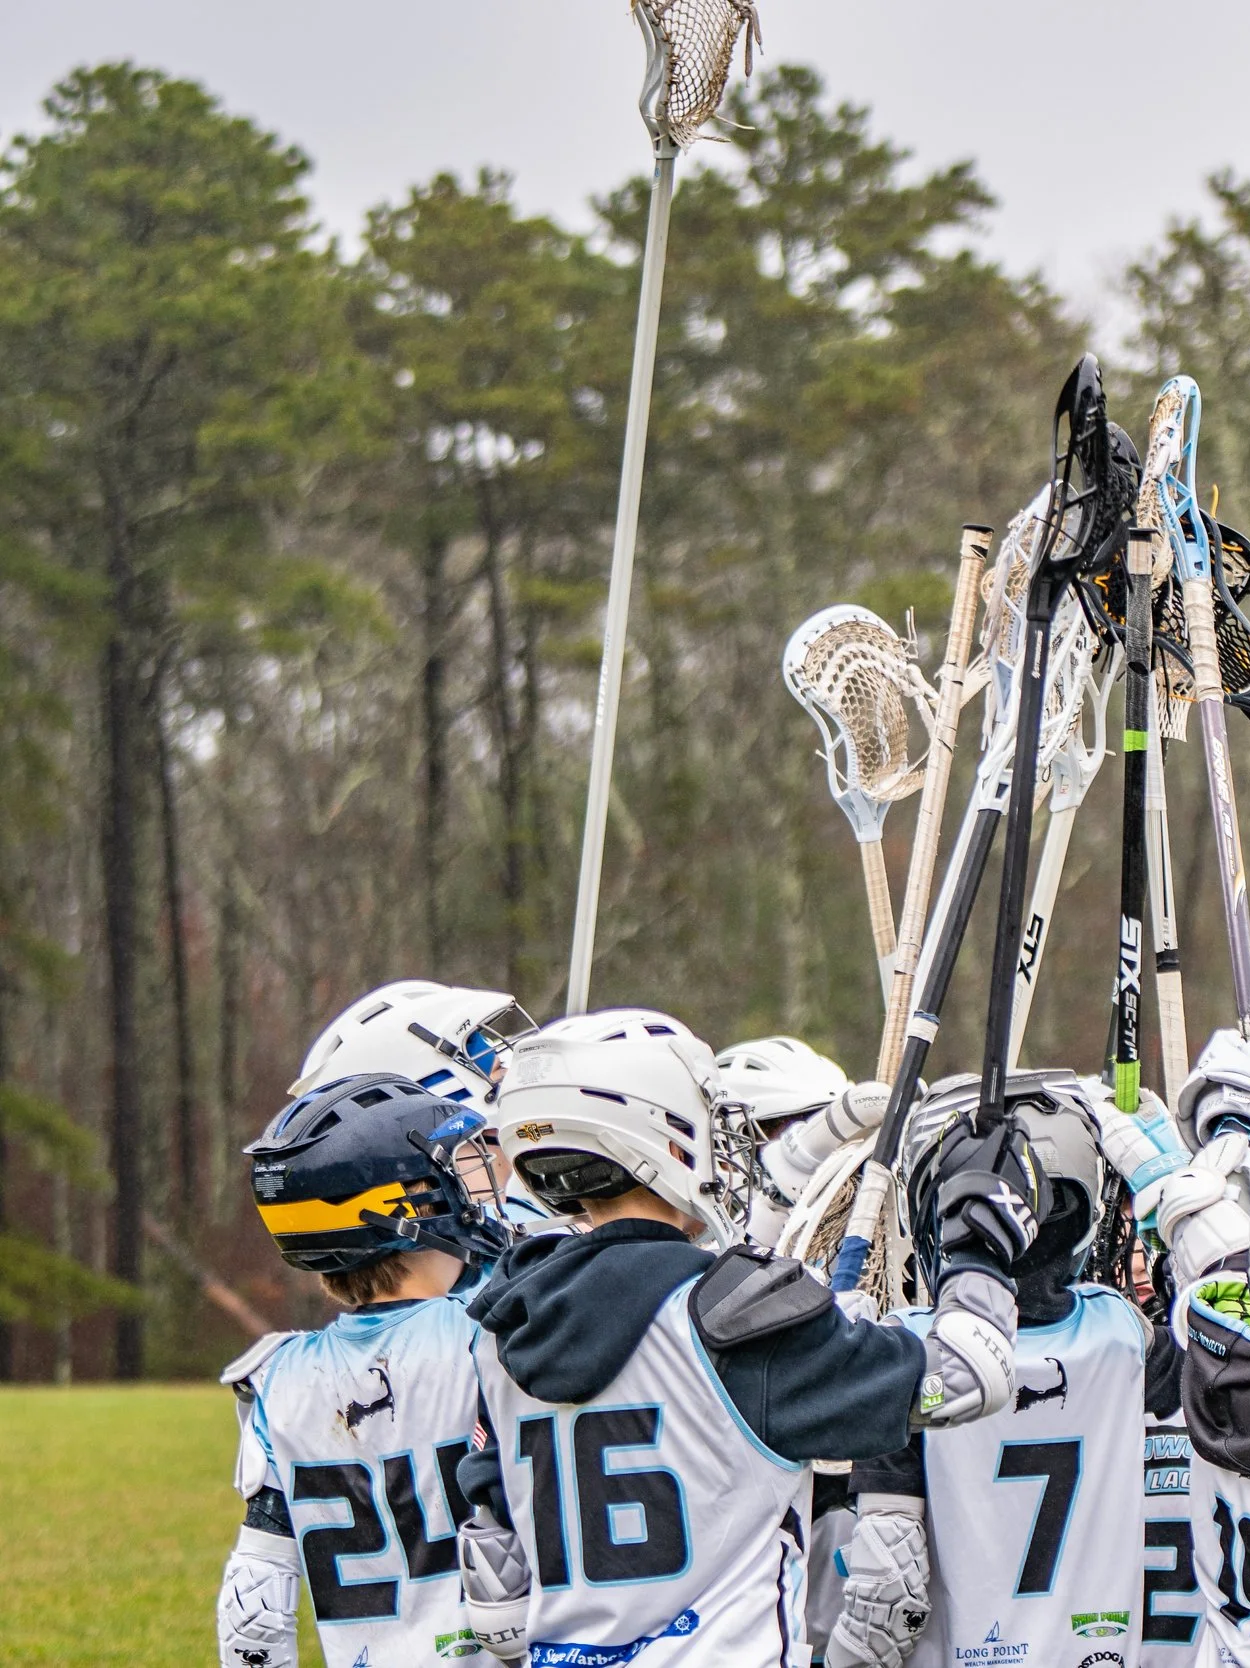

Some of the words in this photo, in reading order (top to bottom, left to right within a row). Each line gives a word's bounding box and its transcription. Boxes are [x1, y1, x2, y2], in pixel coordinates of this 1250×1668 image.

[1211, 735, 1231, 806] BRINE
[1016, 912, 1044, 986] STX
[1119, 912, 1142, 996] STX
[290, 1435, 474, 1626] 24
[516, 1403, 692, 1592] 16
[992, 1435, 1085, 1600] 7
[956, 1647, 989, 1659] LONG
[993, 1643, 1029, 1656] POINT
[987, 1657, 1024, 1666] MANAGEMENT
[1094, 1650, 1120, 1662] DOG
